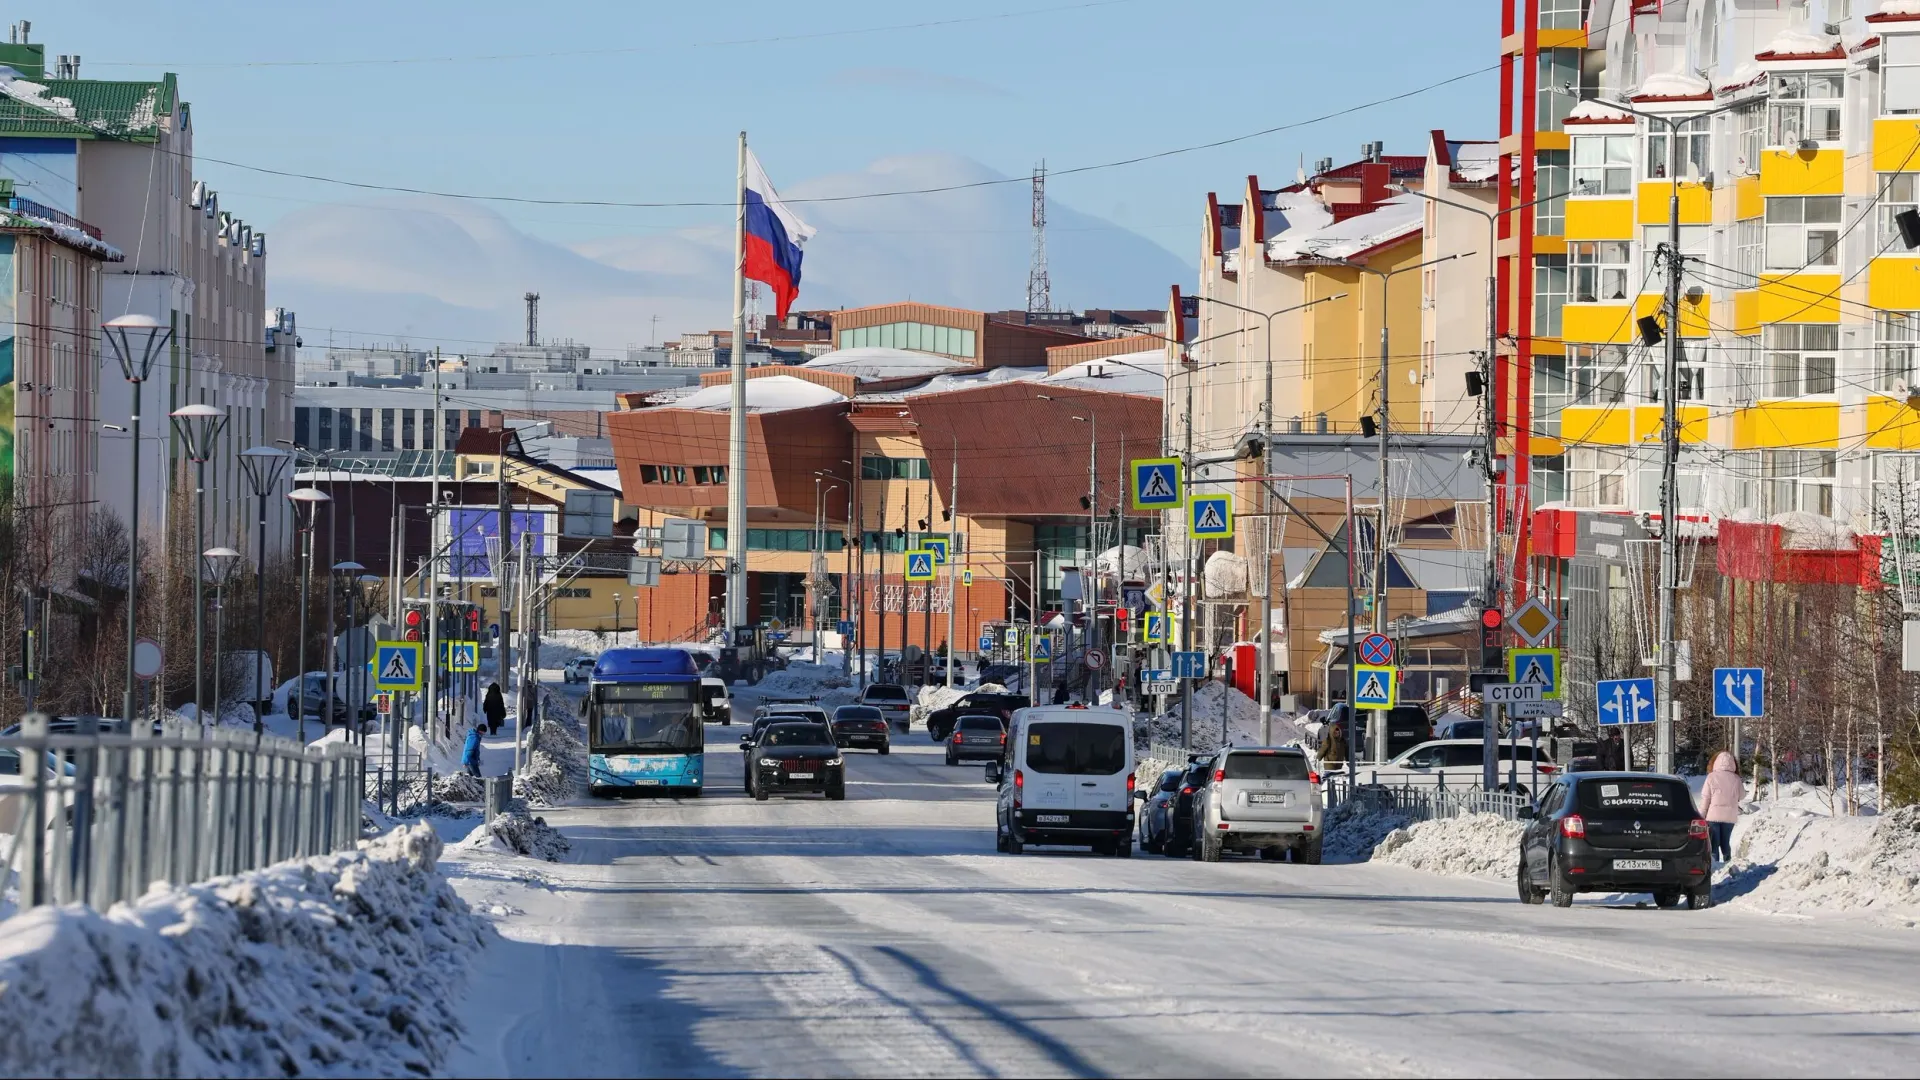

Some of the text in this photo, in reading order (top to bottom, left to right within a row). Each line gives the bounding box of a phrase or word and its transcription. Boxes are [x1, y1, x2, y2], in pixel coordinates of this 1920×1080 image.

[1485, 630, 1502, 647] 20
[1146, 684, 1173, 693] СТОП
[1491, 686, 1534, 700] СТОП
[1611, 798, 1669, 807] 8(34922) 777-88
